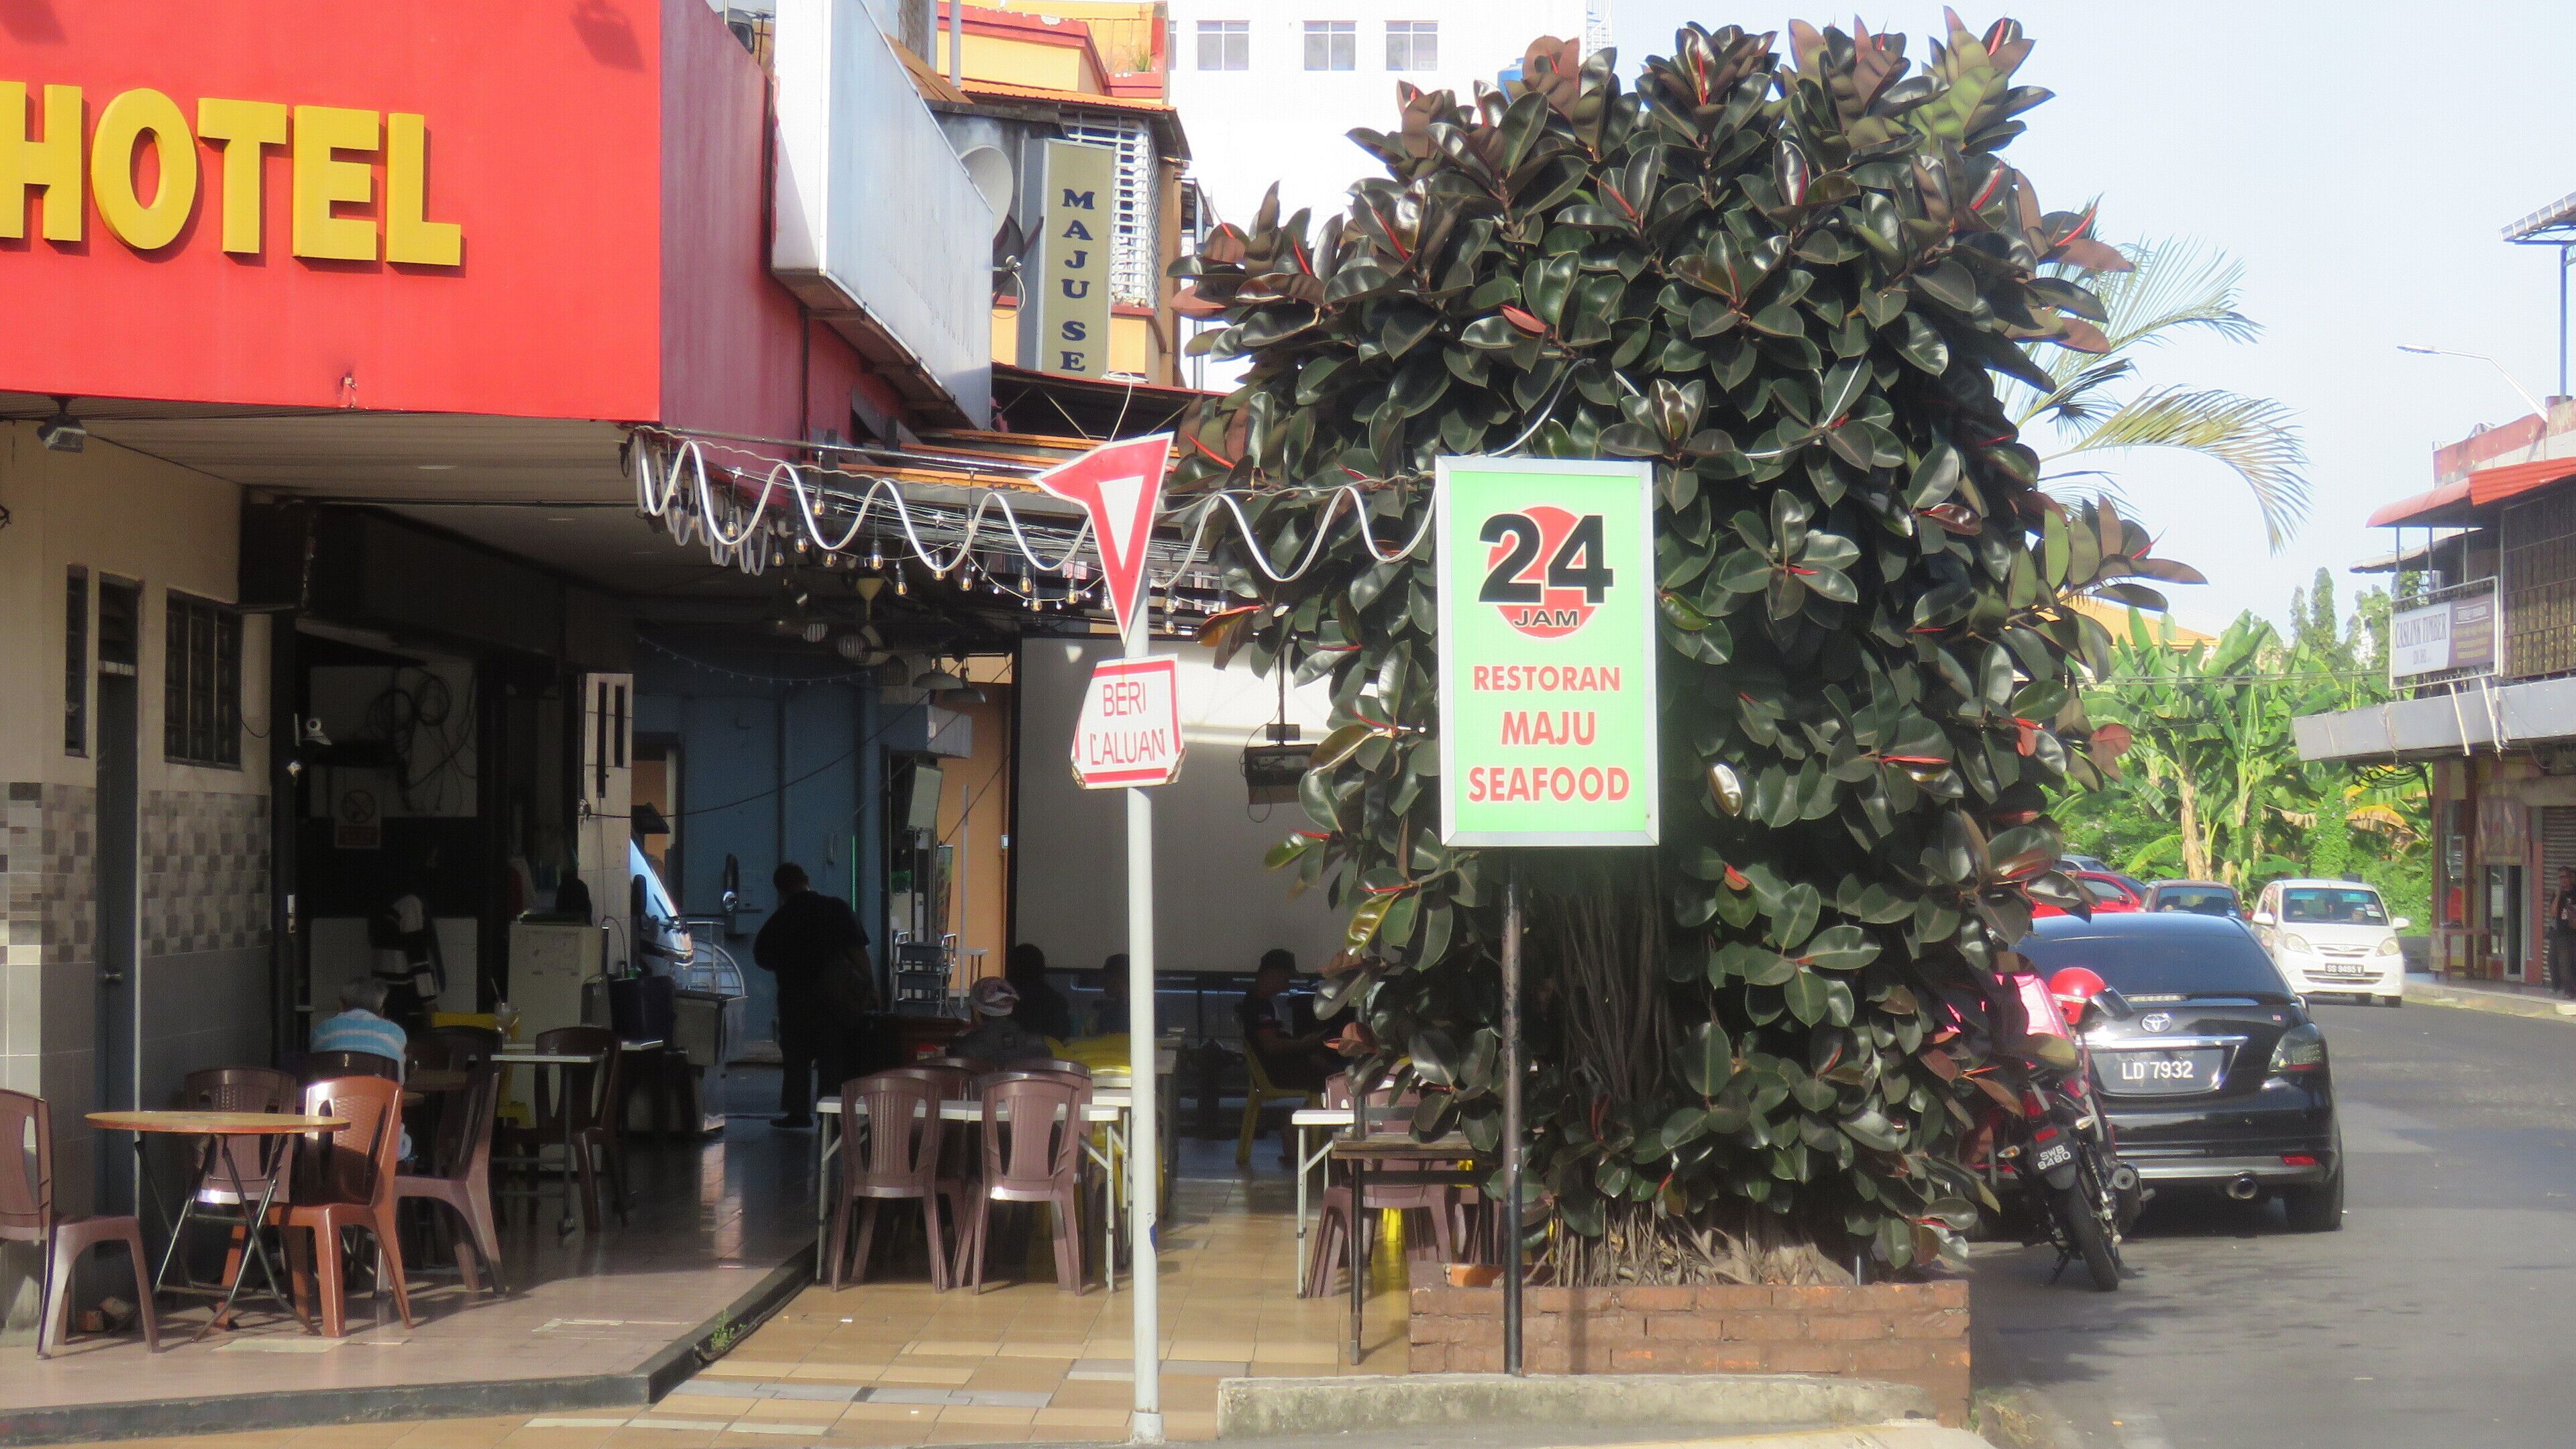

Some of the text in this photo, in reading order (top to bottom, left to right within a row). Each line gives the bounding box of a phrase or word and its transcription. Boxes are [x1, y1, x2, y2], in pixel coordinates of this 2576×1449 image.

[0, 80, 461, 266] HOTEL
[1061, 188, 1095, 299] MAJU
[1479, 513, 1615, 604] 24
[1514, 609, 1579, 627] JAM
[1474, 665, 1620, 692] RESTORAN
[1102, 682, 1147, 717] BERI
[1501, 711, 1595, 745] MAJU
[1468, 767, 1629, 802] SEAFOOD
[2122, 1061, 2194, 1080] LD 7932
[2039, 1144, 2065, 1161] SWB
